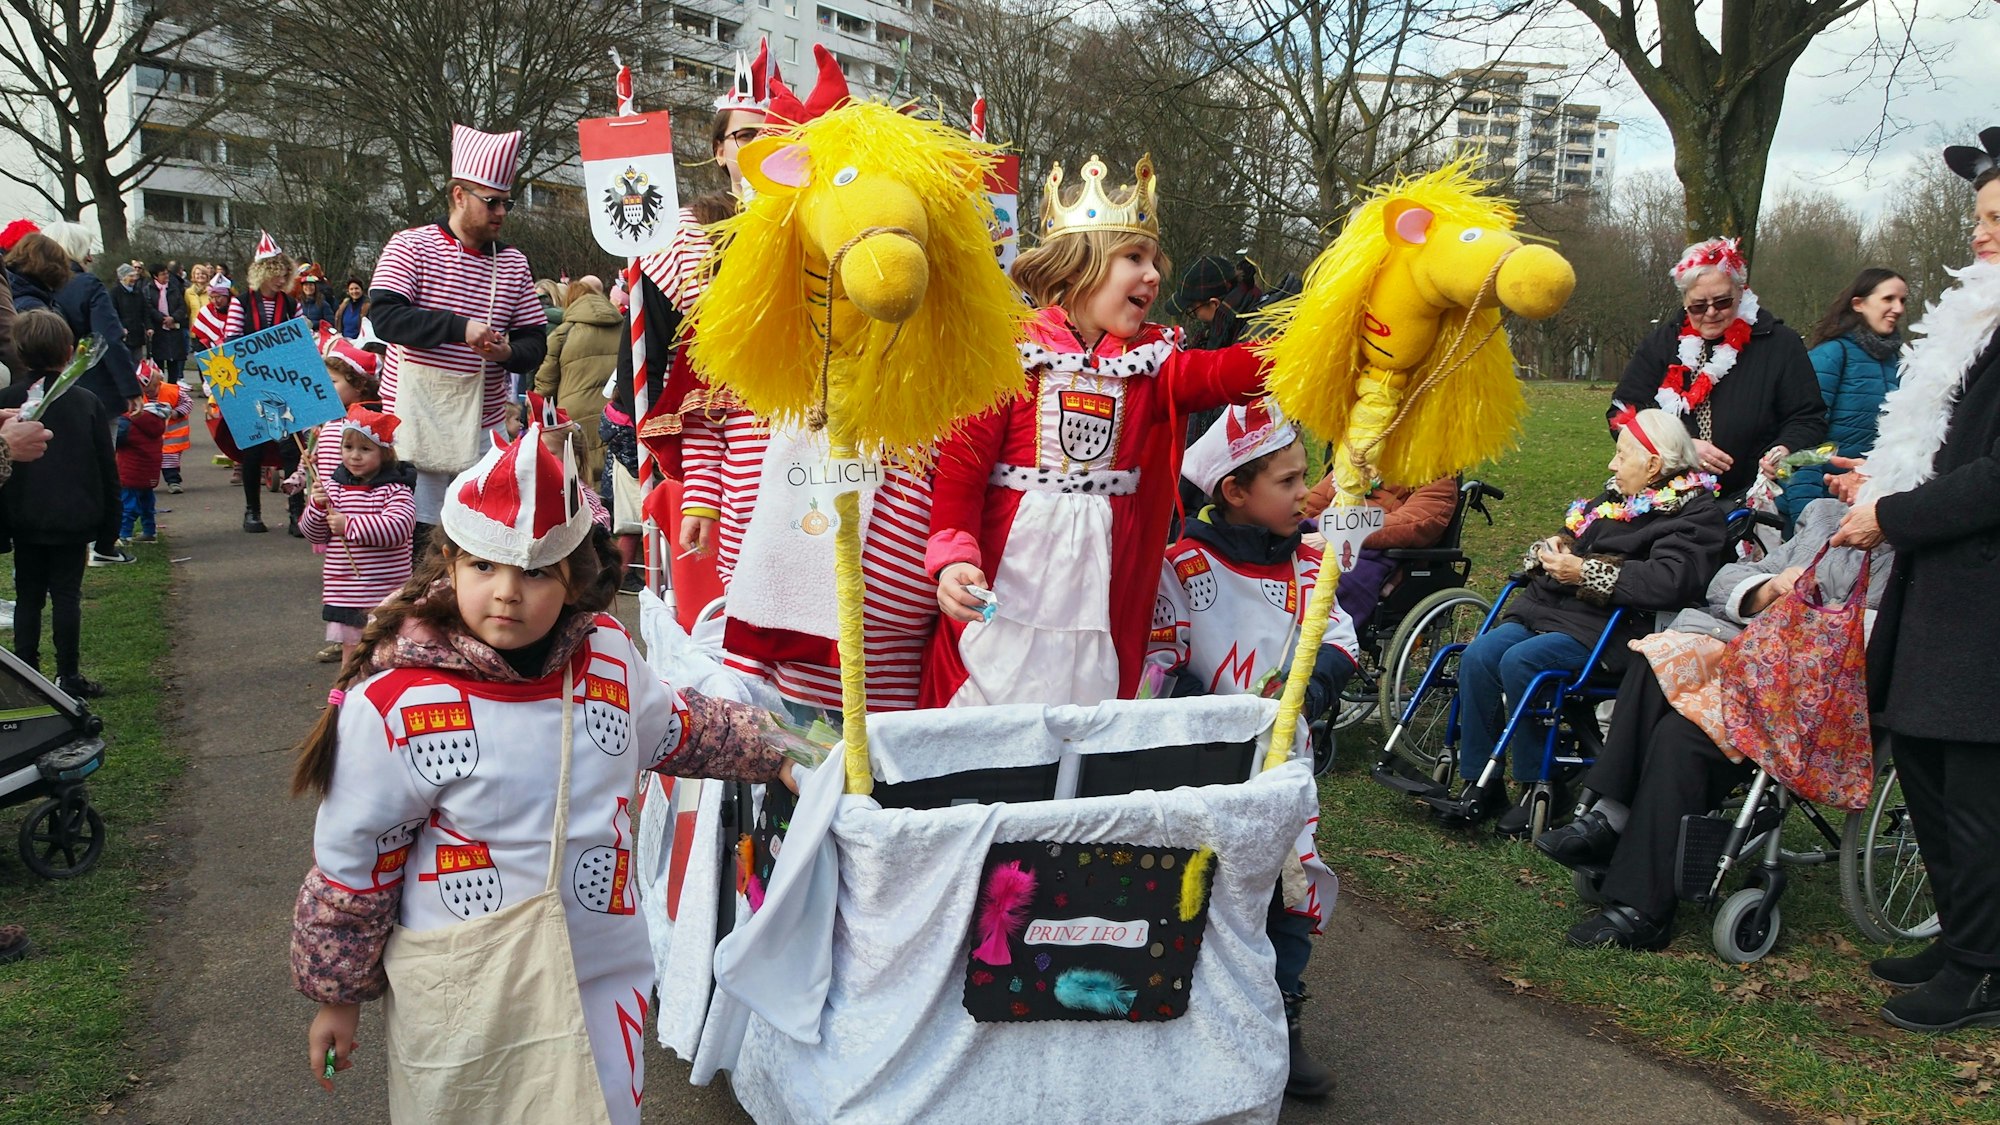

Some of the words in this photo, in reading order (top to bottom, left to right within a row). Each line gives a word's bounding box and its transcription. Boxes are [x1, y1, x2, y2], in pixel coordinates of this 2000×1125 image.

[234, 323, 303, 358] SONNEN
[245, 360, 327, 401] GRUPPE
[249, 431, 262, 441] und
[787, 462, 878, 486] ÖLLICH
[1323, 508, 1382, 531] FLÖNZ
[1026, 925, 1089, 941] PRINZ
[1089, 926, 1127, 941] LEO
